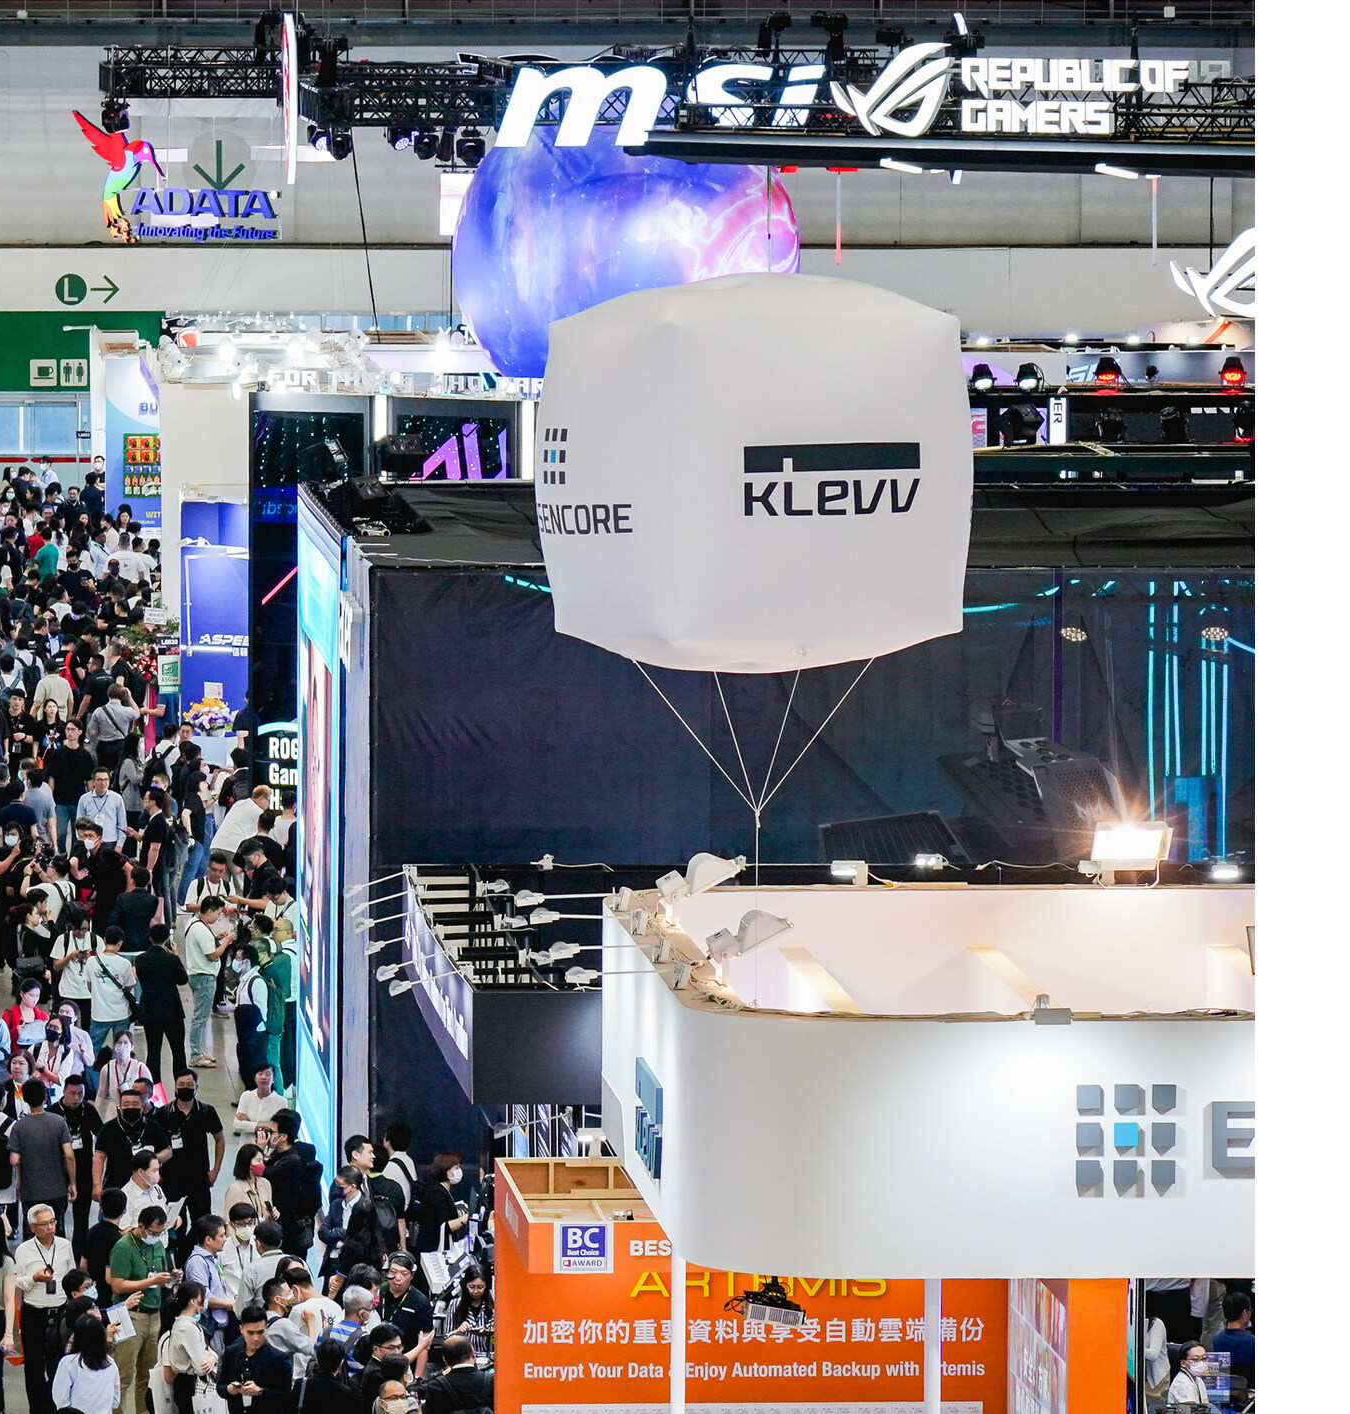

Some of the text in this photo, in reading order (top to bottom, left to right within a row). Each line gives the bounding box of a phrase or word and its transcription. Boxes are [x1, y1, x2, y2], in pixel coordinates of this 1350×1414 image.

[962, 57, 1139, 98] REPUBLIC
[1140, 59, 1192, 93] OF
[495, 64, 826, 147] msi
[962, 100, 1116, 134] GAMERS
[130, 187, 277, 219] ADATA
[137, 222, 275, 241] Innovating the Future
[567, 1227, 600, 1249] BC
[572, 1259, 603, 1267] AWARD
[524, 1363, 584, 1381] Encrypt
[589, 1363, 623, 1378] Your
[628, 1362, 664, 1378] Data
[685, 1362, 728, 1381] Enjoy
[731, 1361, 817, 1378] Automated
[822, 1361, 881, 1380] Backup
[885, 1361, 919, 1377] with
